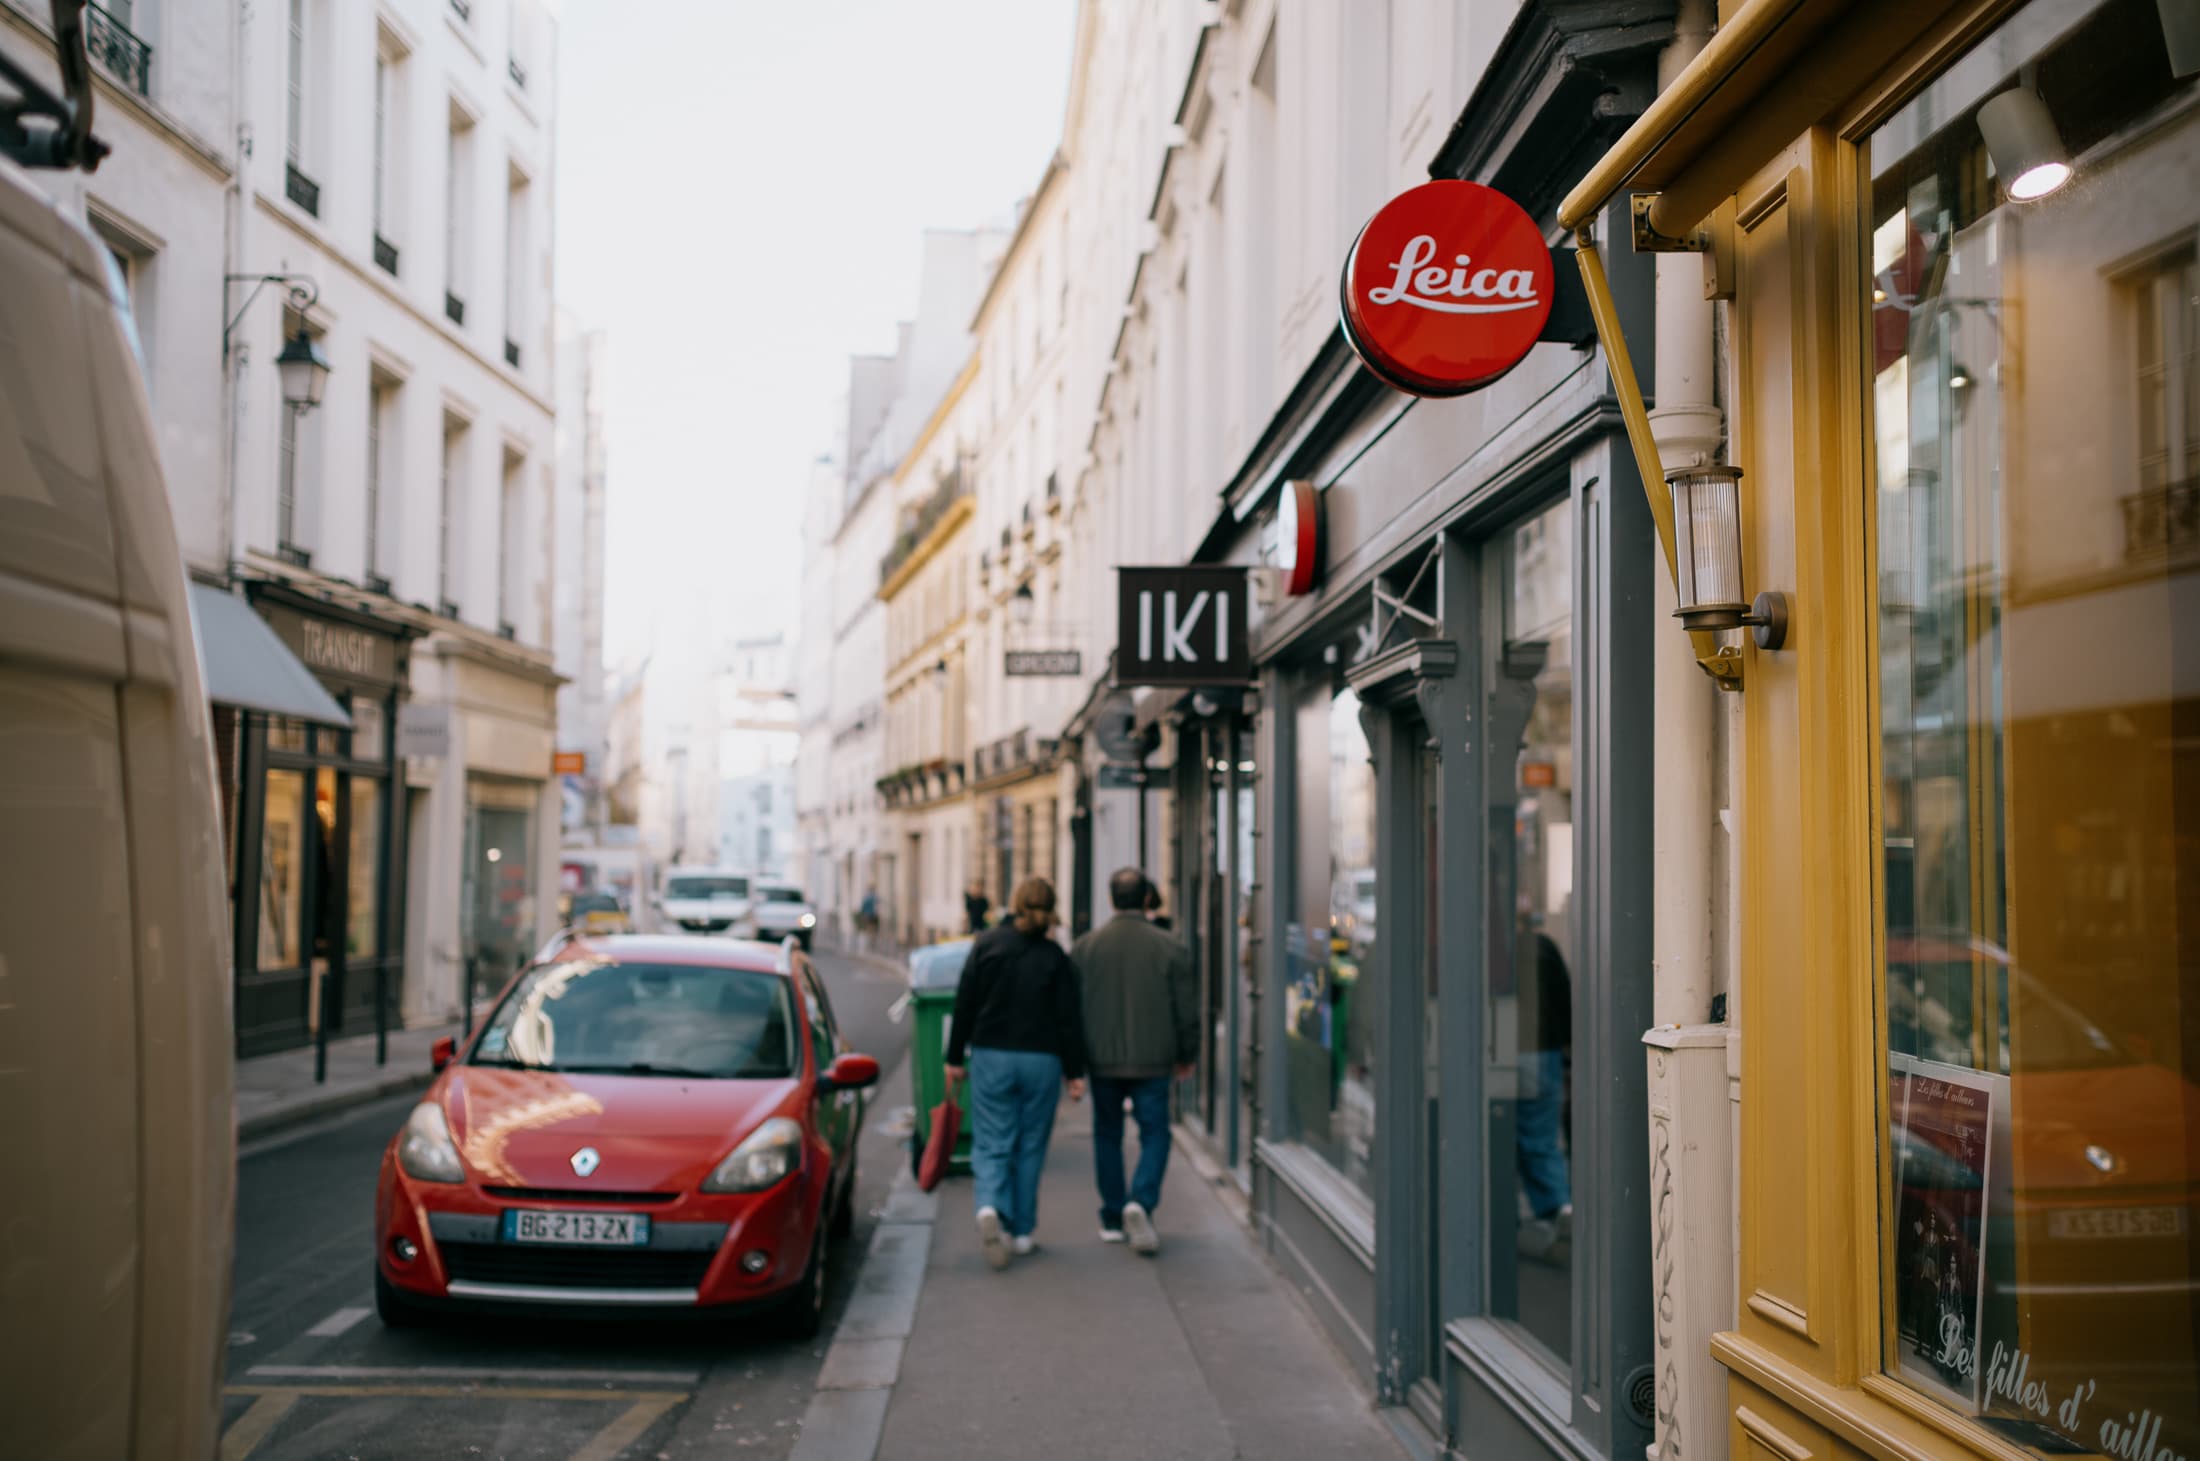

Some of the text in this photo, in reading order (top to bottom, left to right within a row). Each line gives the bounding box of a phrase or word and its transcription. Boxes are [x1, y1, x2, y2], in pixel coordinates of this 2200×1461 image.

[1369, 234, 1540, 314] Leica
[303, 619, 374, 673] TRANSIT
[1139, 589, 1229, 662] IKI
[1936, 1313, 1978, 1380] Les
[1983, 1340, 2049, 1417] filles
